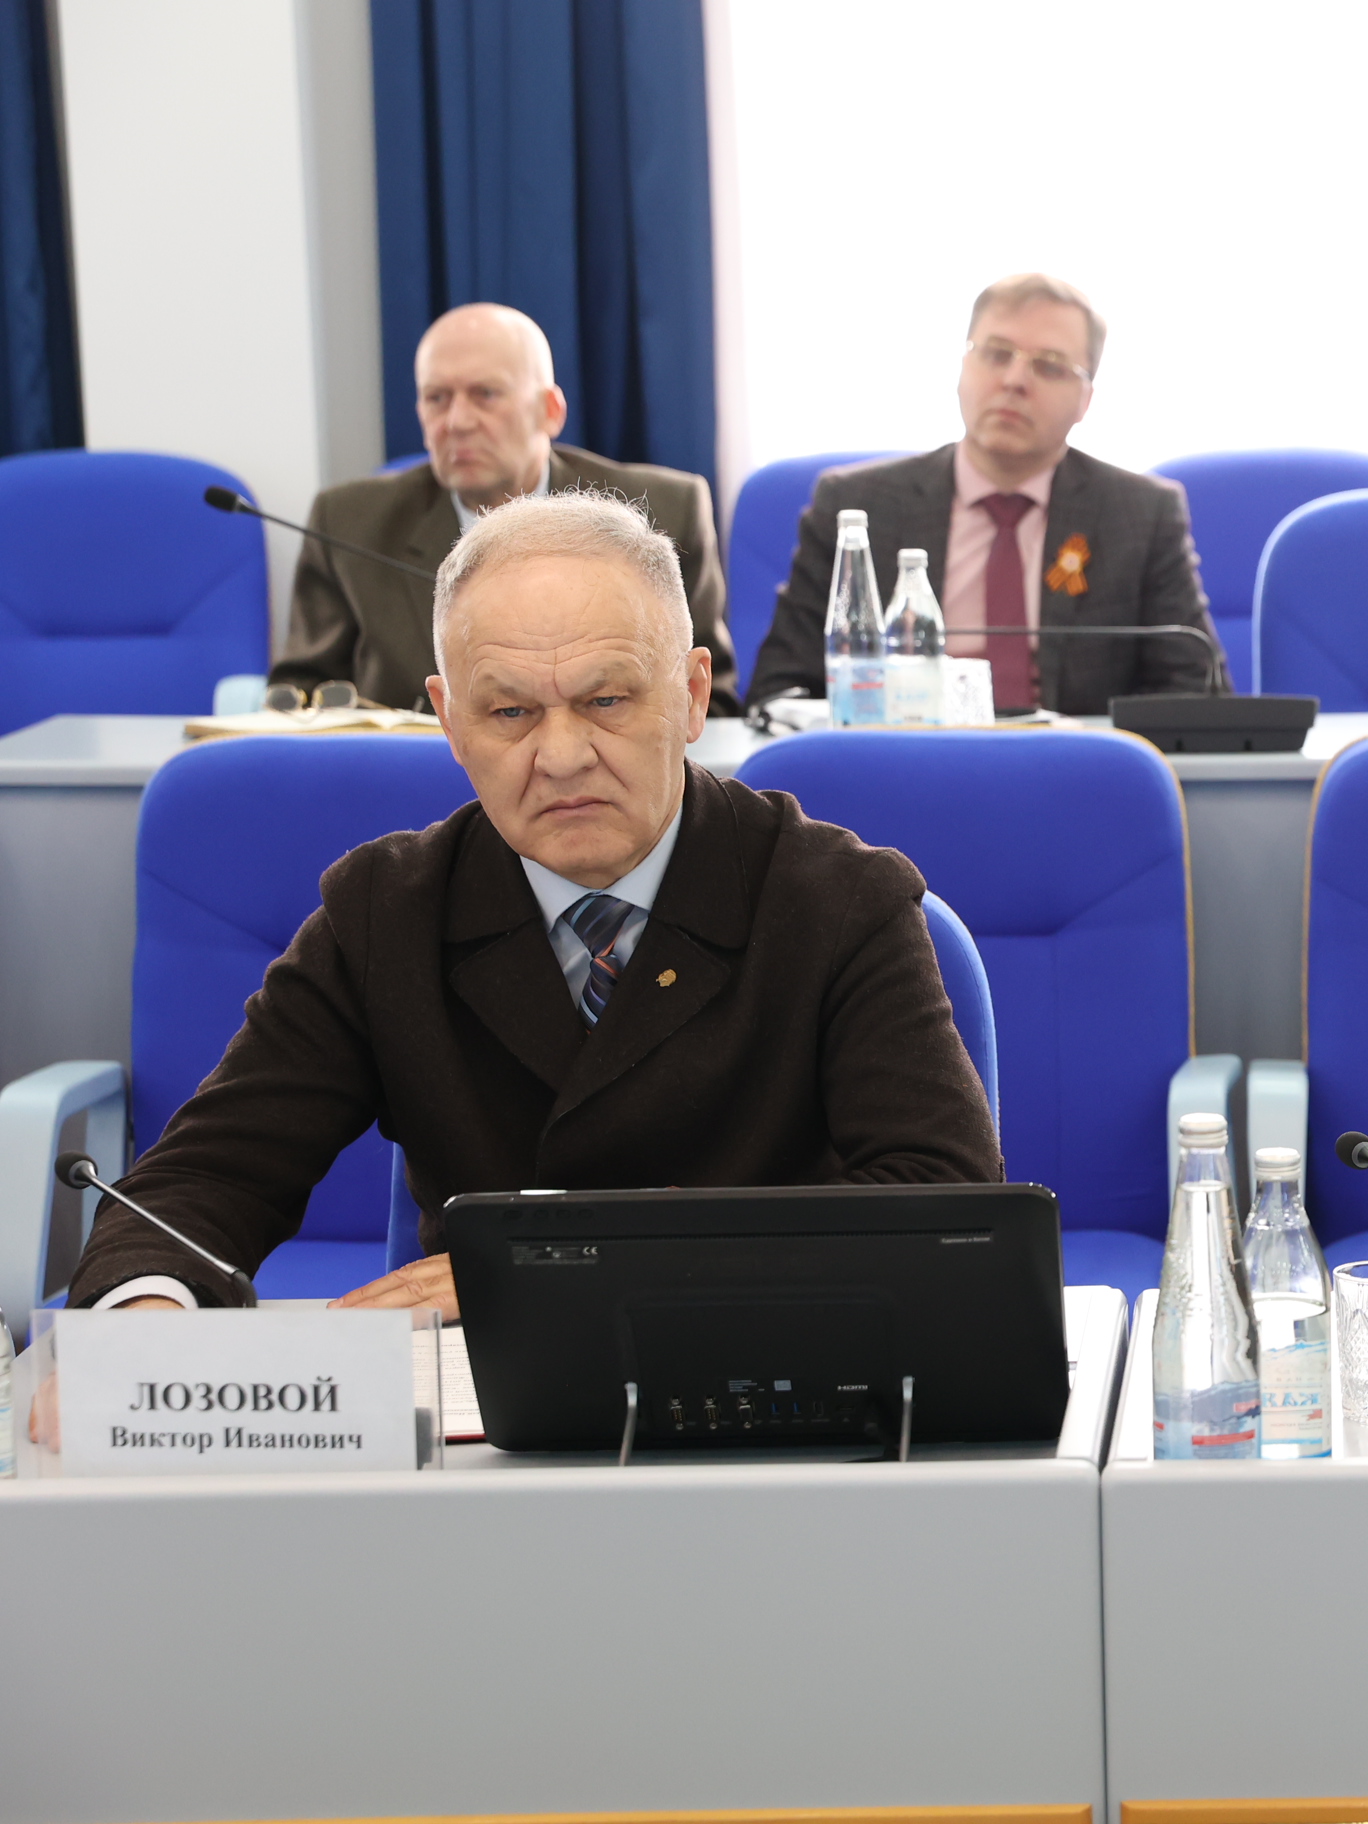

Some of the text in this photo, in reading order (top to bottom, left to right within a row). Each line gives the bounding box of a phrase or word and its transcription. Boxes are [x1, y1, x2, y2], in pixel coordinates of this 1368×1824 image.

[129, 1376, 340, 1413] ЛОЗОВОЙ
[110, 1426, 363, 1454] Виктор Иванович
